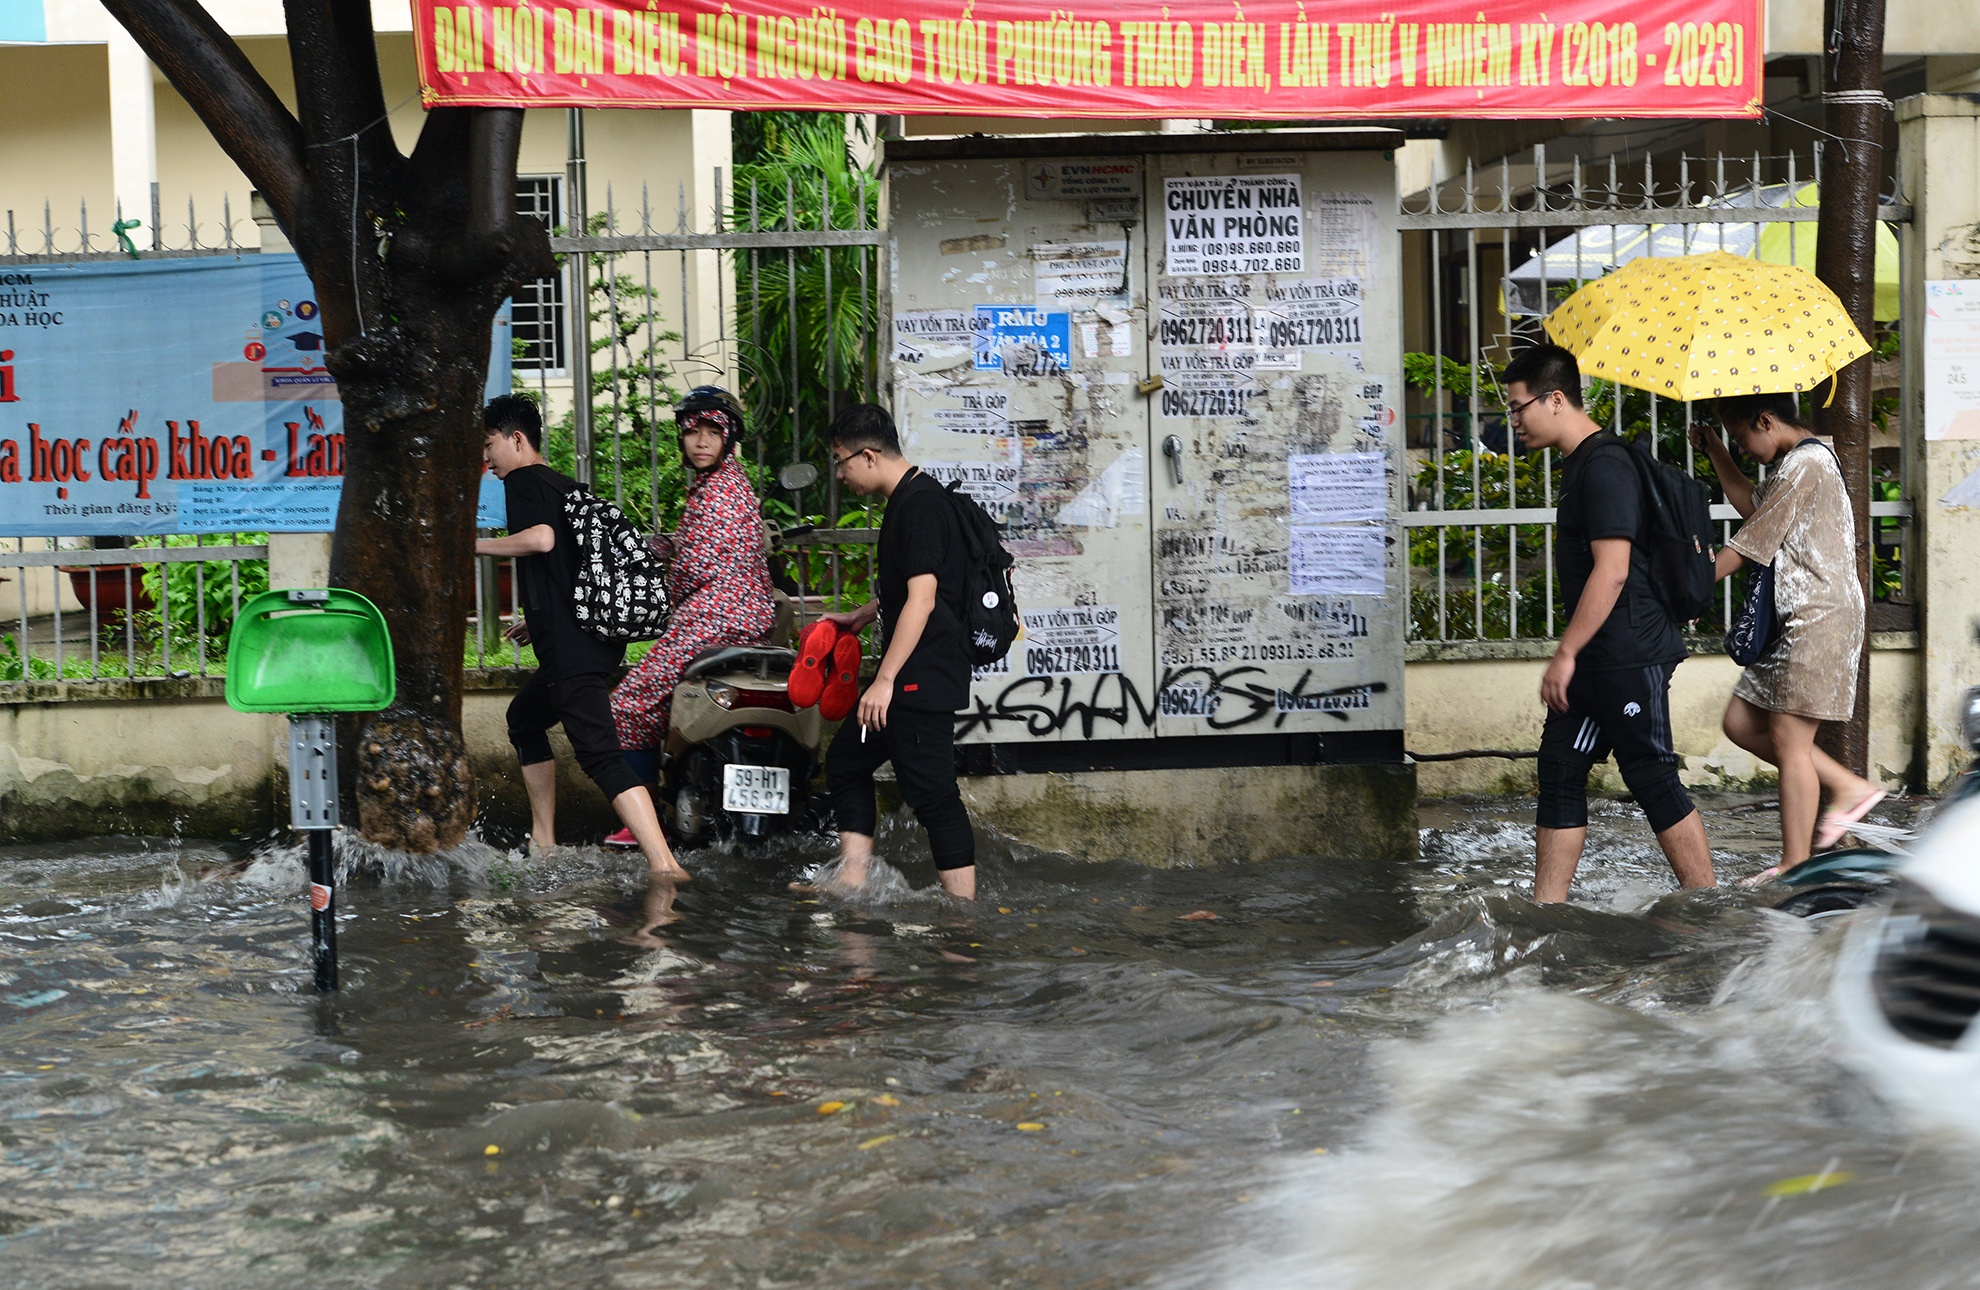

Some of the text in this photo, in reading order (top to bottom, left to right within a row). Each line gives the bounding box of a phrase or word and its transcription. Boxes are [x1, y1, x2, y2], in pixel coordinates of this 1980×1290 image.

[434, 6, 485, 86] ĐẠI
[492, 0, 544, 87] HỘI
[553, 7, 604, 88] ĐẠI
[696, 2, 747, 90] HỘI
[756, 6, 847, 82] NGƯỜI
[855, 17, 912, 84] CAO
[920, 0, 988, 85] TUỔI
[996, 9, 1112, 87] PHƯỜNG
[1120, 6, 1194, 88] THẢO
[1201, 0, 1271, 94] ĐIỀN,
[1279, 1, 1330, 88] LẦN
[1337, 12, 1396, 88] THỨ
[1400, 23, 1420, 87] V
[1426, 11, 1511, 99] NHIỆM
[1520, 12, 1555, 87] KỲ
[1168, 178, 1300, 211] CHUYỂN NHÀ
[1169, 210, 1299, 240] VĂN PHÒNG
[1289, 282, 1312, 300] VỐN
[1314, 280, 1336, 299] TRẢ
[1337, 279, 1359, 298] GÓP
[25, 311, 64, 329] HỌC
[896, 319, 918, 333] VAY
[920, 313, 942, 332] VỐN
[944, 313, 966, 332] TRẢ
[1050, 334, 1061, 349] 2
[1161, 356, 1182, 370] VAY
[1209, 352, 1231, 370] TRẢ
[963, 390, 1007, 409] TRẢ GÓP
[27, 422, 92, 500] học
[100, 409, 159, 499] cấp
[166, 420, 254, 481] khoa
[947, 461, 970, 481] VỐN
[971, 463, 993, 482] TRẢ
[995, 464, 1017, 482] GÓP
[44, 503, 78, 515] Thời
[81, 504, 113, 518] gian
[116, 502, 152, 518] đăng
[1023, 606, 1118, 628] VAY VỐN TRẢ GÓP
[735, 769, 778, 789] 59-H1
